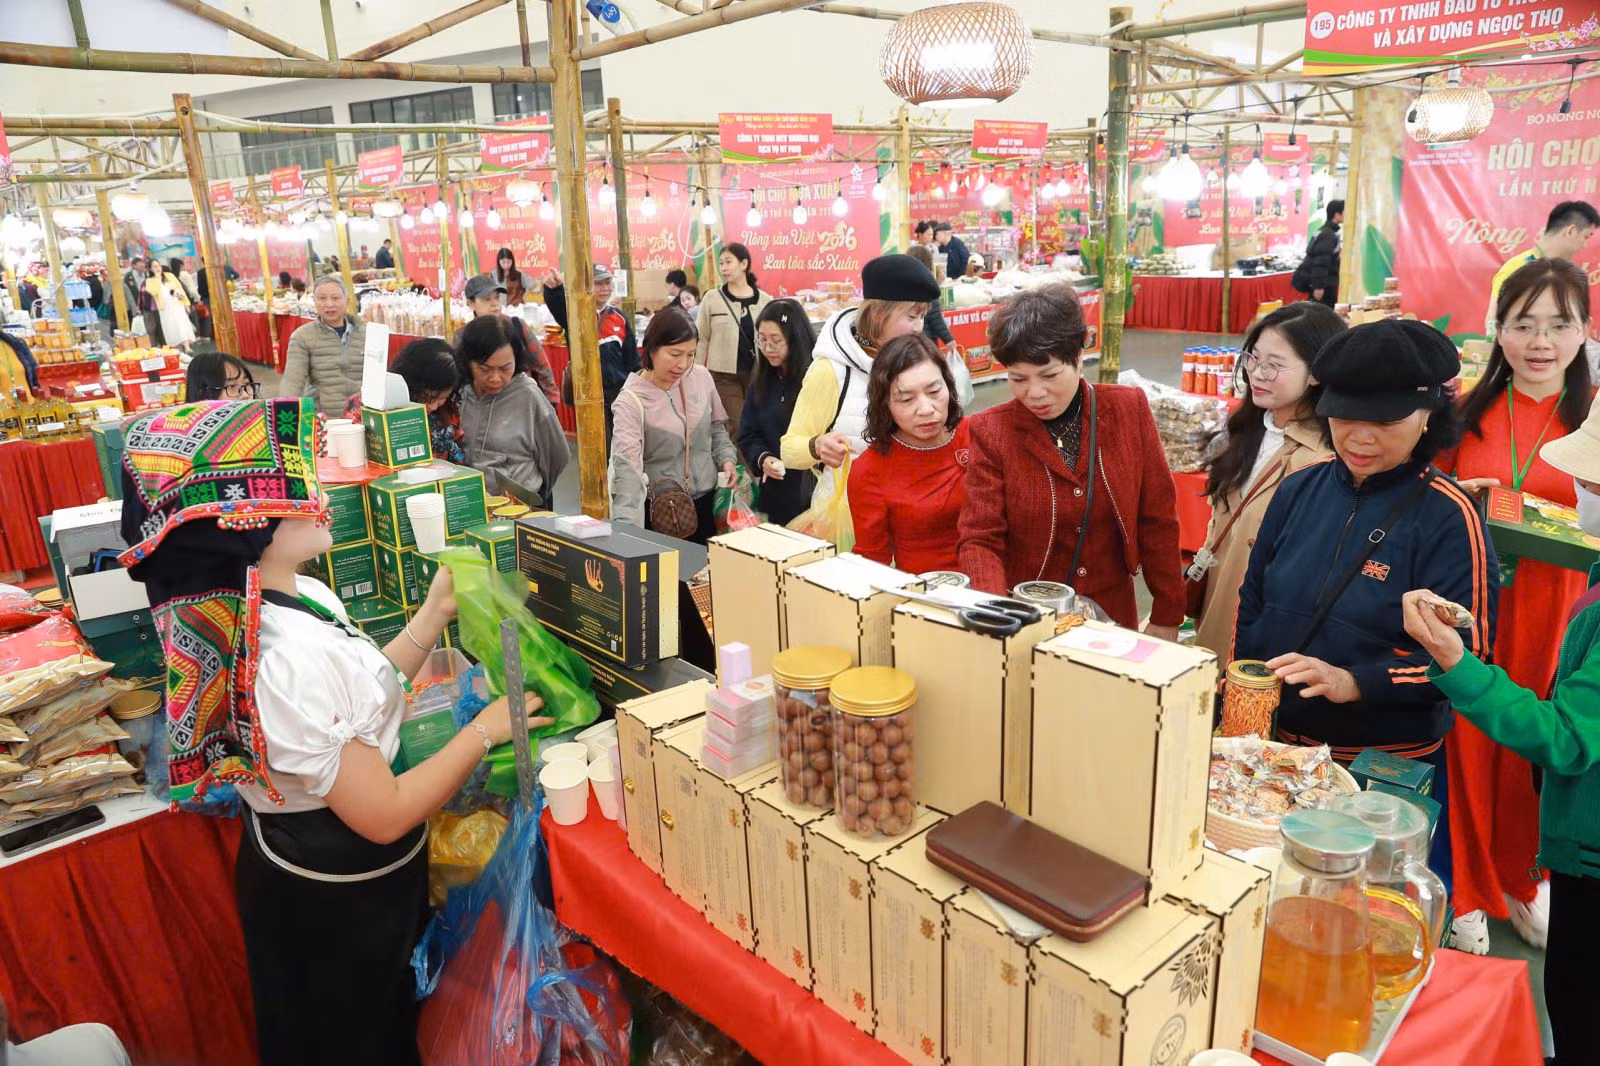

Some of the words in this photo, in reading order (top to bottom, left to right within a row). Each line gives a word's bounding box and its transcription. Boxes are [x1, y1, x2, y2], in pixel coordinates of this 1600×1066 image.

[1314, 19, 1331, 31] 195
[1337, 10, 1376, 30] CÔNG
[1379, 7, 1397, 25] TY
[1400, 1, 1441, 22] TNHH
[1373, 28, 1391, 48] VÀ
[1395, 25, 1426, 46] XÂY
[1429, 20, 1474, 43] DỰNG
[1477, 13, 1525, 36] NGỌC
[1530, 7, 1564, 30] THỌ
[1487, 138, 1535, 174] HỘI
[741, 229, 770, 250] Nông
[790, 229, 816, 249] Việt
[1445, 217, 1528, 253] Nông
[763, 254, 787, 270] Lan
[826, 254, 859, 271] Xuân
